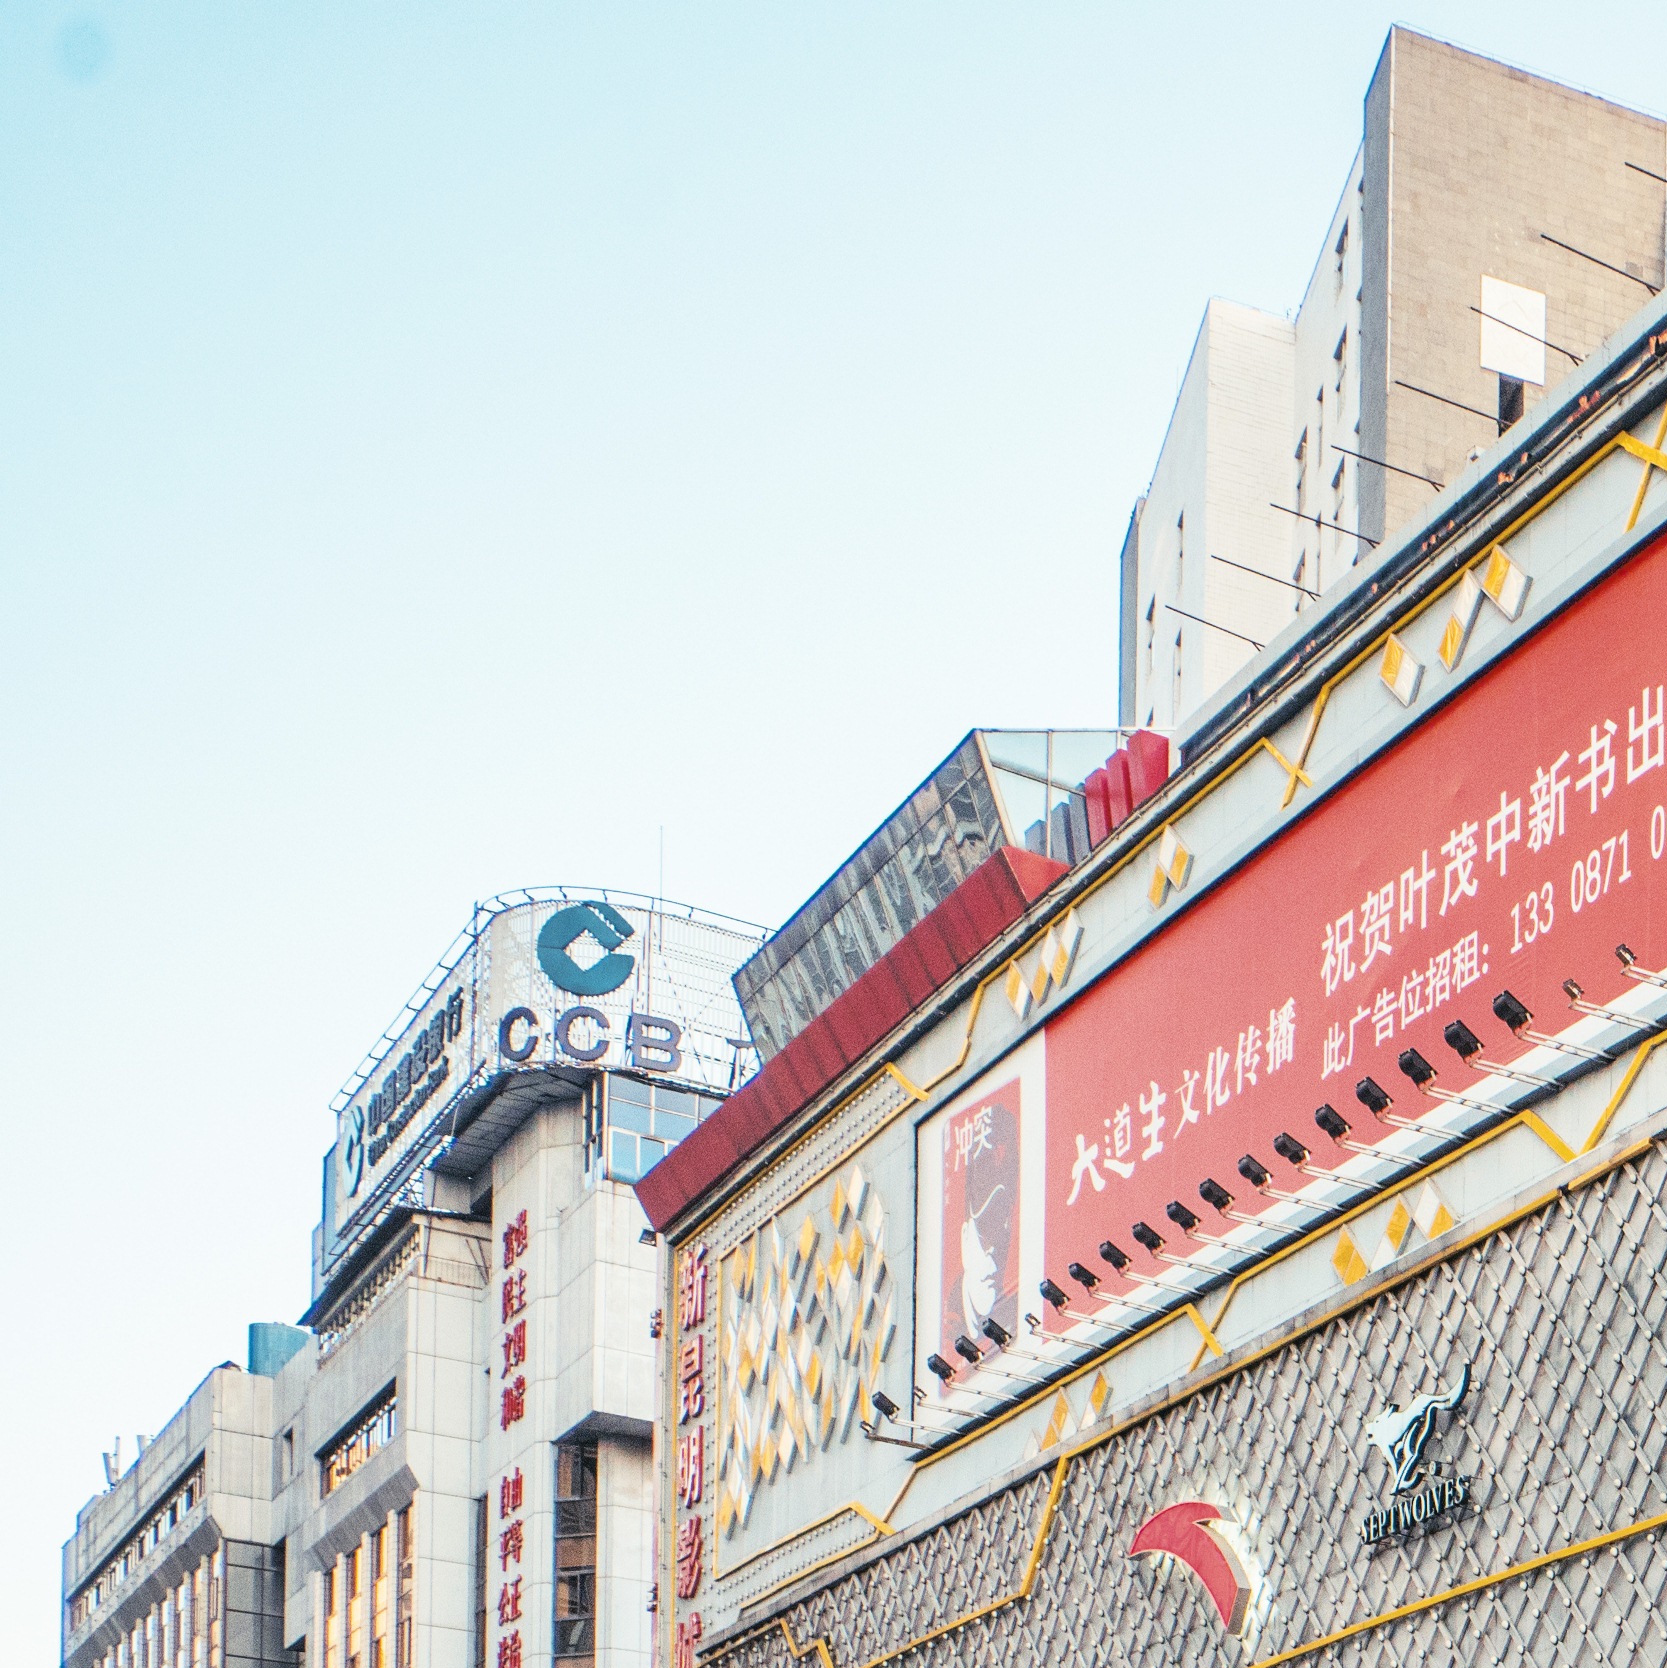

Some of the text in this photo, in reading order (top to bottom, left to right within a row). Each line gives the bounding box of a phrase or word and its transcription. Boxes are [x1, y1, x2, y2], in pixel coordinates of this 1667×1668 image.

[1509, 889, 1555, 953] 133
[1568, 842, 1632, 921] 0871
[500, 1005, 682, 1073] CCB
[1066, 997, 1297, 1206] 大道生文化传播
[954, 1105, 993, 1172] 冲突
[1361, 1475, 1470, 1545] SEPTWOLVES
